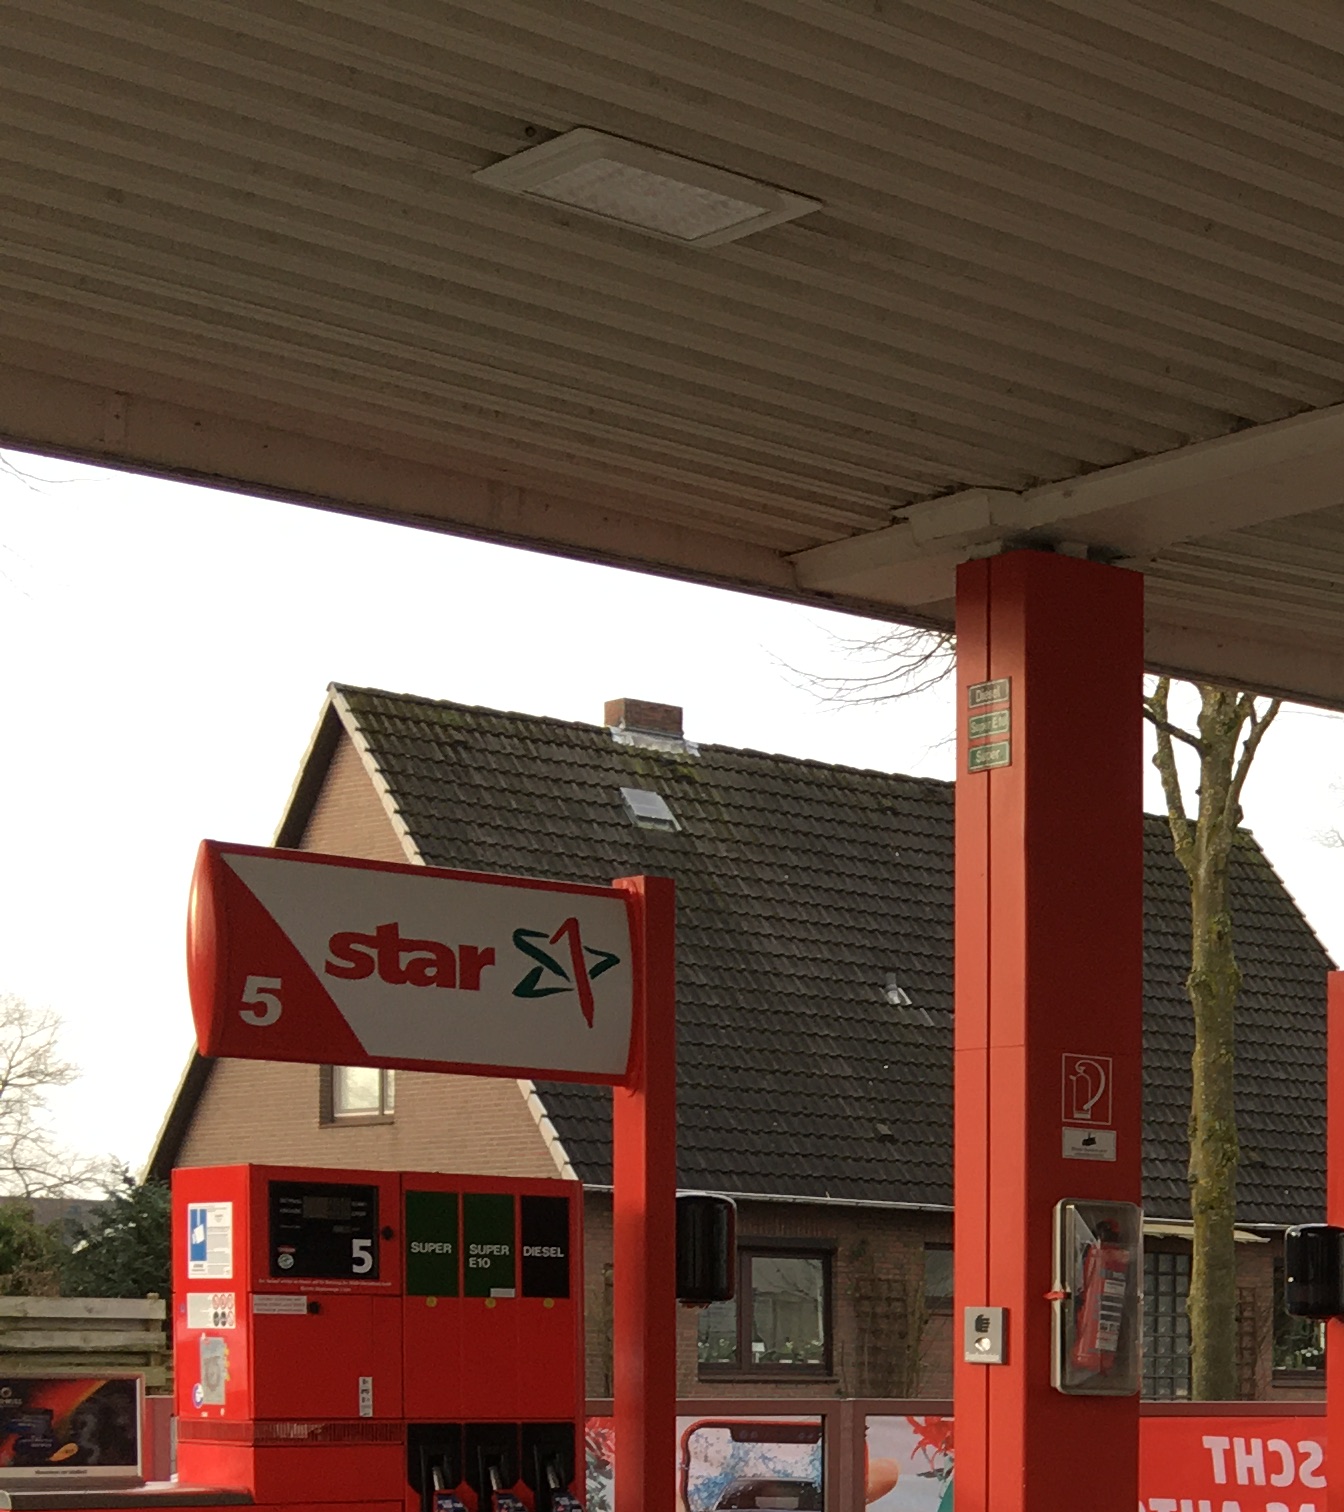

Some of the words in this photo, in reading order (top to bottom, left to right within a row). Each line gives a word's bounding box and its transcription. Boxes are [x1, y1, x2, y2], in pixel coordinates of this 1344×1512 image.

[324, 922, 495, 991] star
[239, 975, 283, 1026] 5
[410, 1241, 452, 1254] SUPER
[469, 1243, 510, 1256] SUPER
[523, 1245, 564, 1258] DIESEL
[352, 1238, 373, 1274] 5
[468, 1257, 491, 1268] E10
